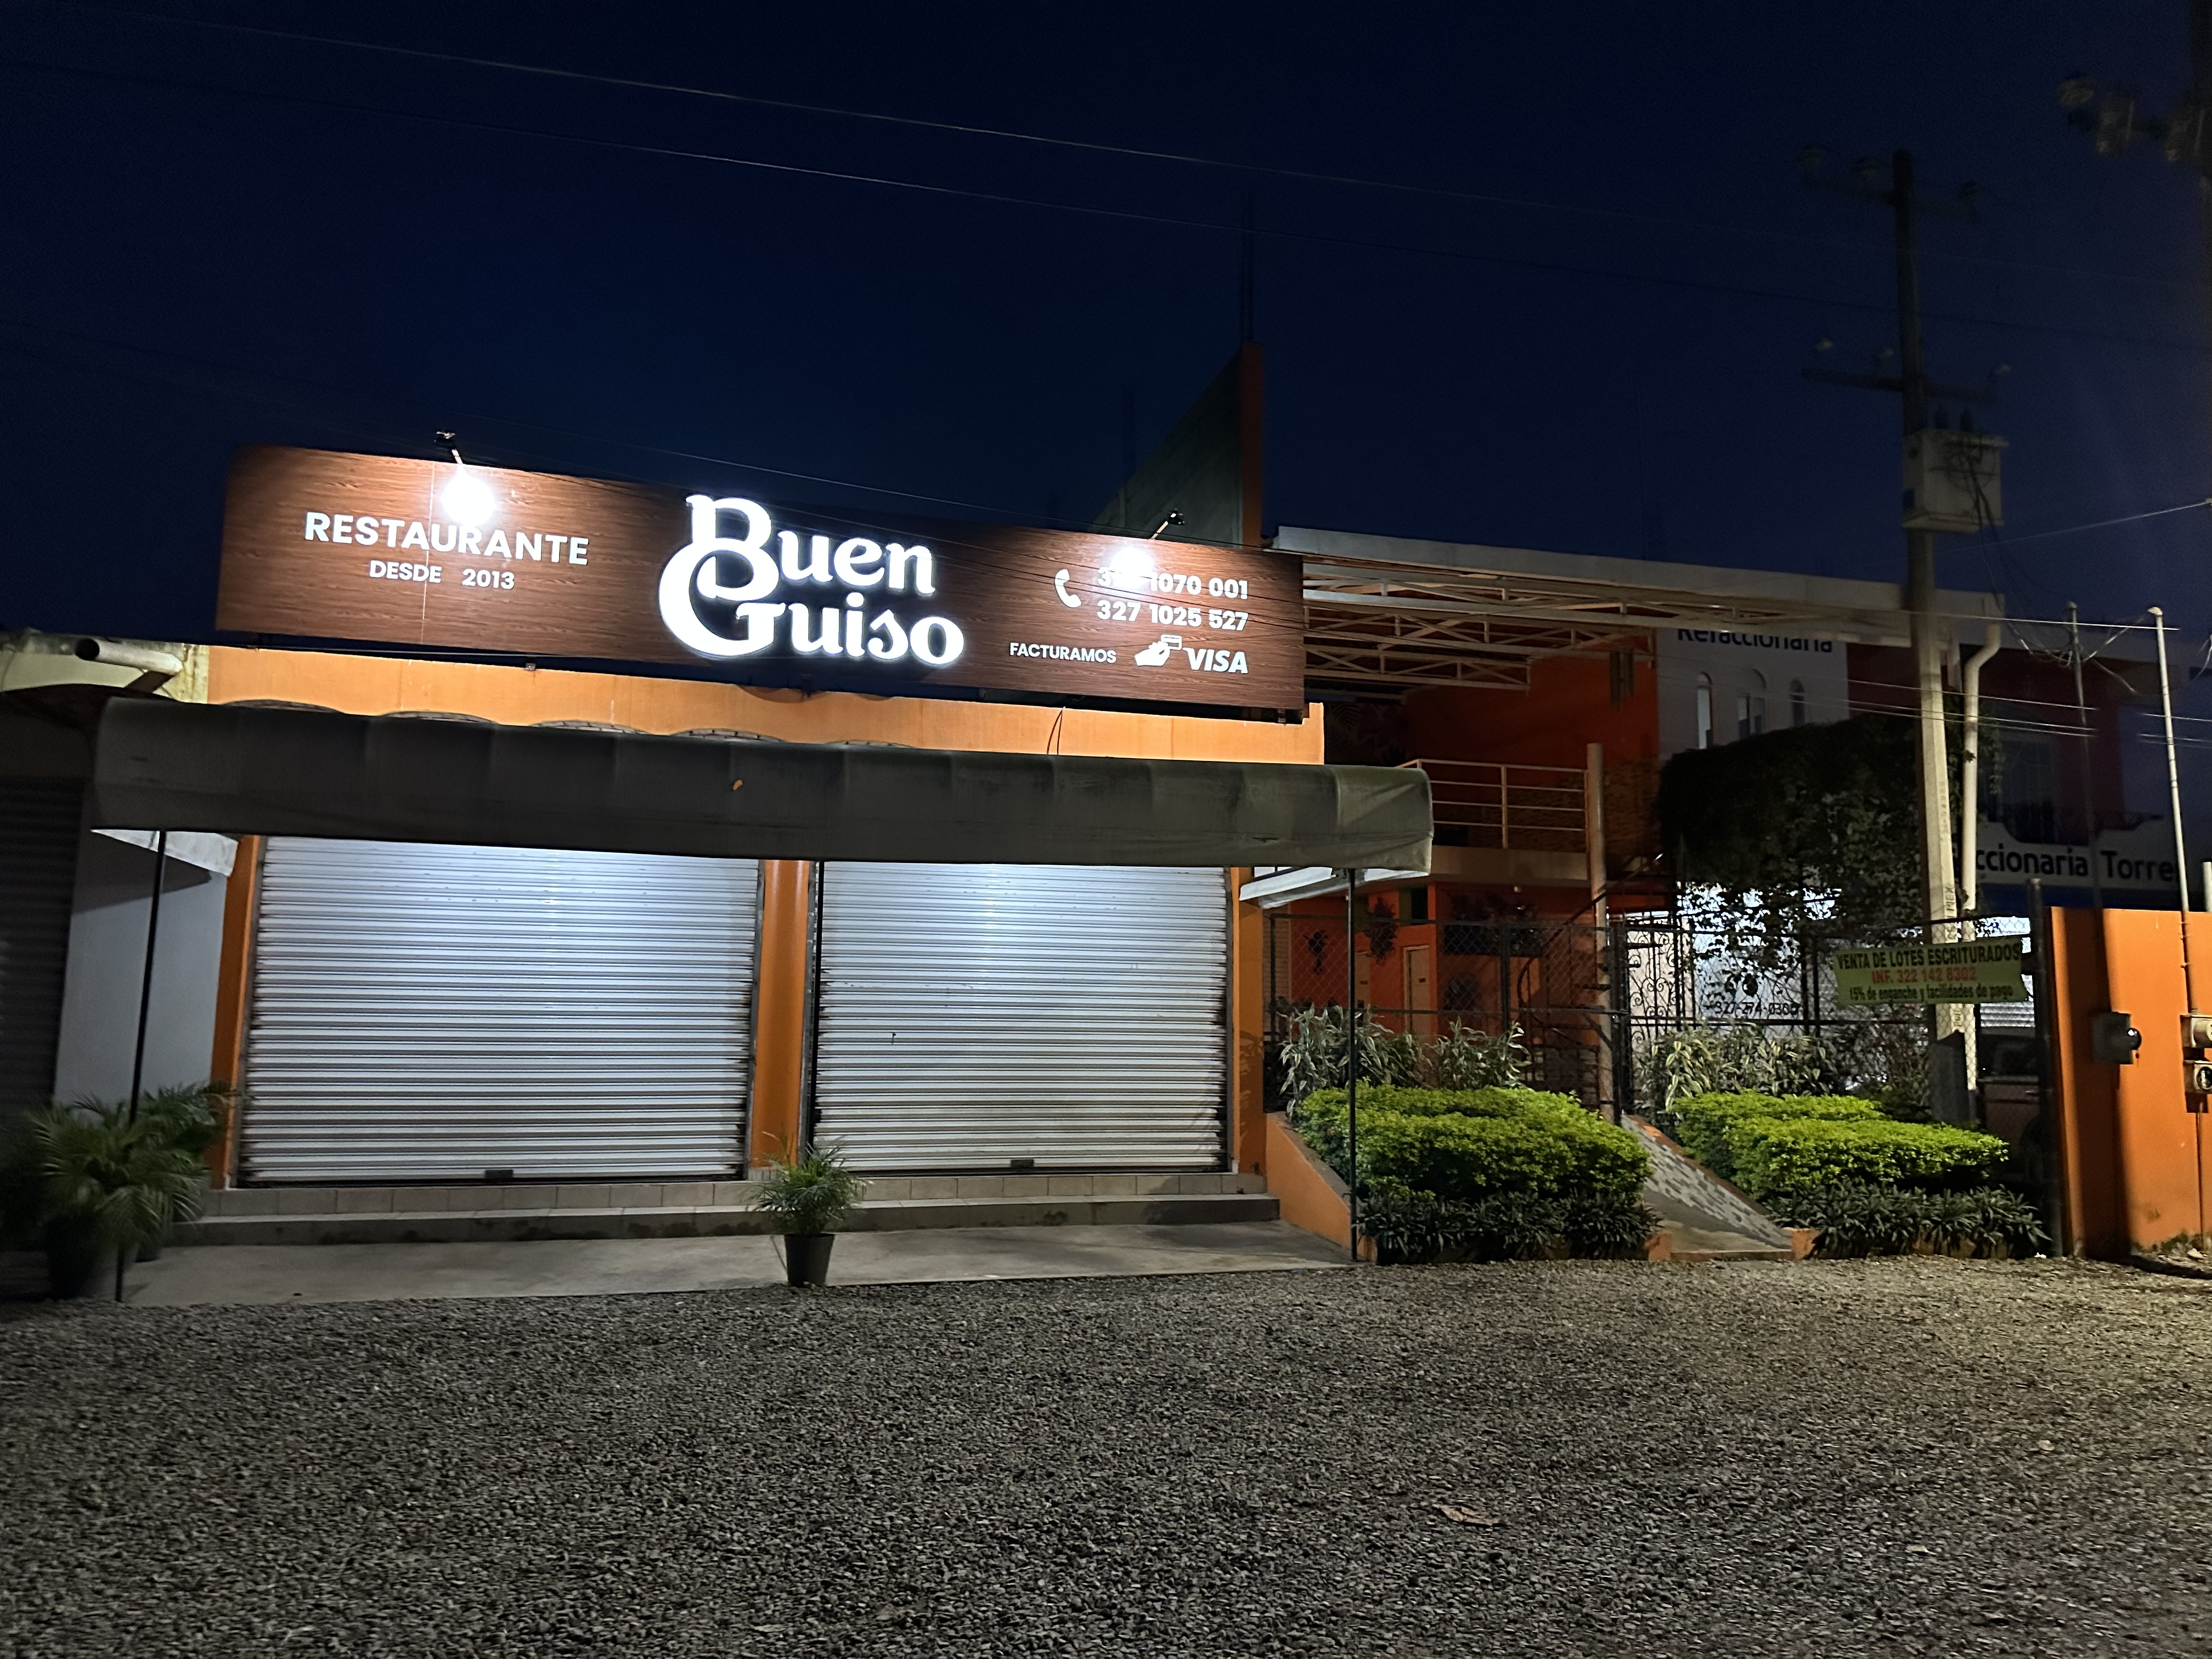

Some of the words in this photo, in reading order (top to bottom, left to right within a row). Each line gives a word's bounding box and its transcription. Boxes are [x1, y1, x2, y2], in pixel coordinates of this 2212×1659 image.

[304, 511, 590, 566] RESTAURANTE
[685, 494, 936, 601] Buen
[369, 560, 442, 584] DESDE
[462, 568, 516, 590] 2013
[1149, 571, 1202, 595] 1070
[1209, 578, 1248, 600] 001
[658, 540, 965, 665] Guiso
[1096, 600, 1141, 622] 327
[1149, 603, 1203, 627] 1025
[1209, 609, 1249, 631] 527
[1009, 642, 1117, 664] FACTURAMOS
[1182, 647, 1249, 674] VISA
[2101, 850, 2178, 881] Torre
[1837, 953, 1870, 969] VENTA
[1873, 952, 1887, 968] DE
[1889, 949, 1925, 967] LOTES
[1927, 943, 2021, 965] ESCRITURADOS
[1897, 968, 1918, 983] 322
[1867, 986, 1876, 1000] de
[1976, 983, 1987, 998] de
